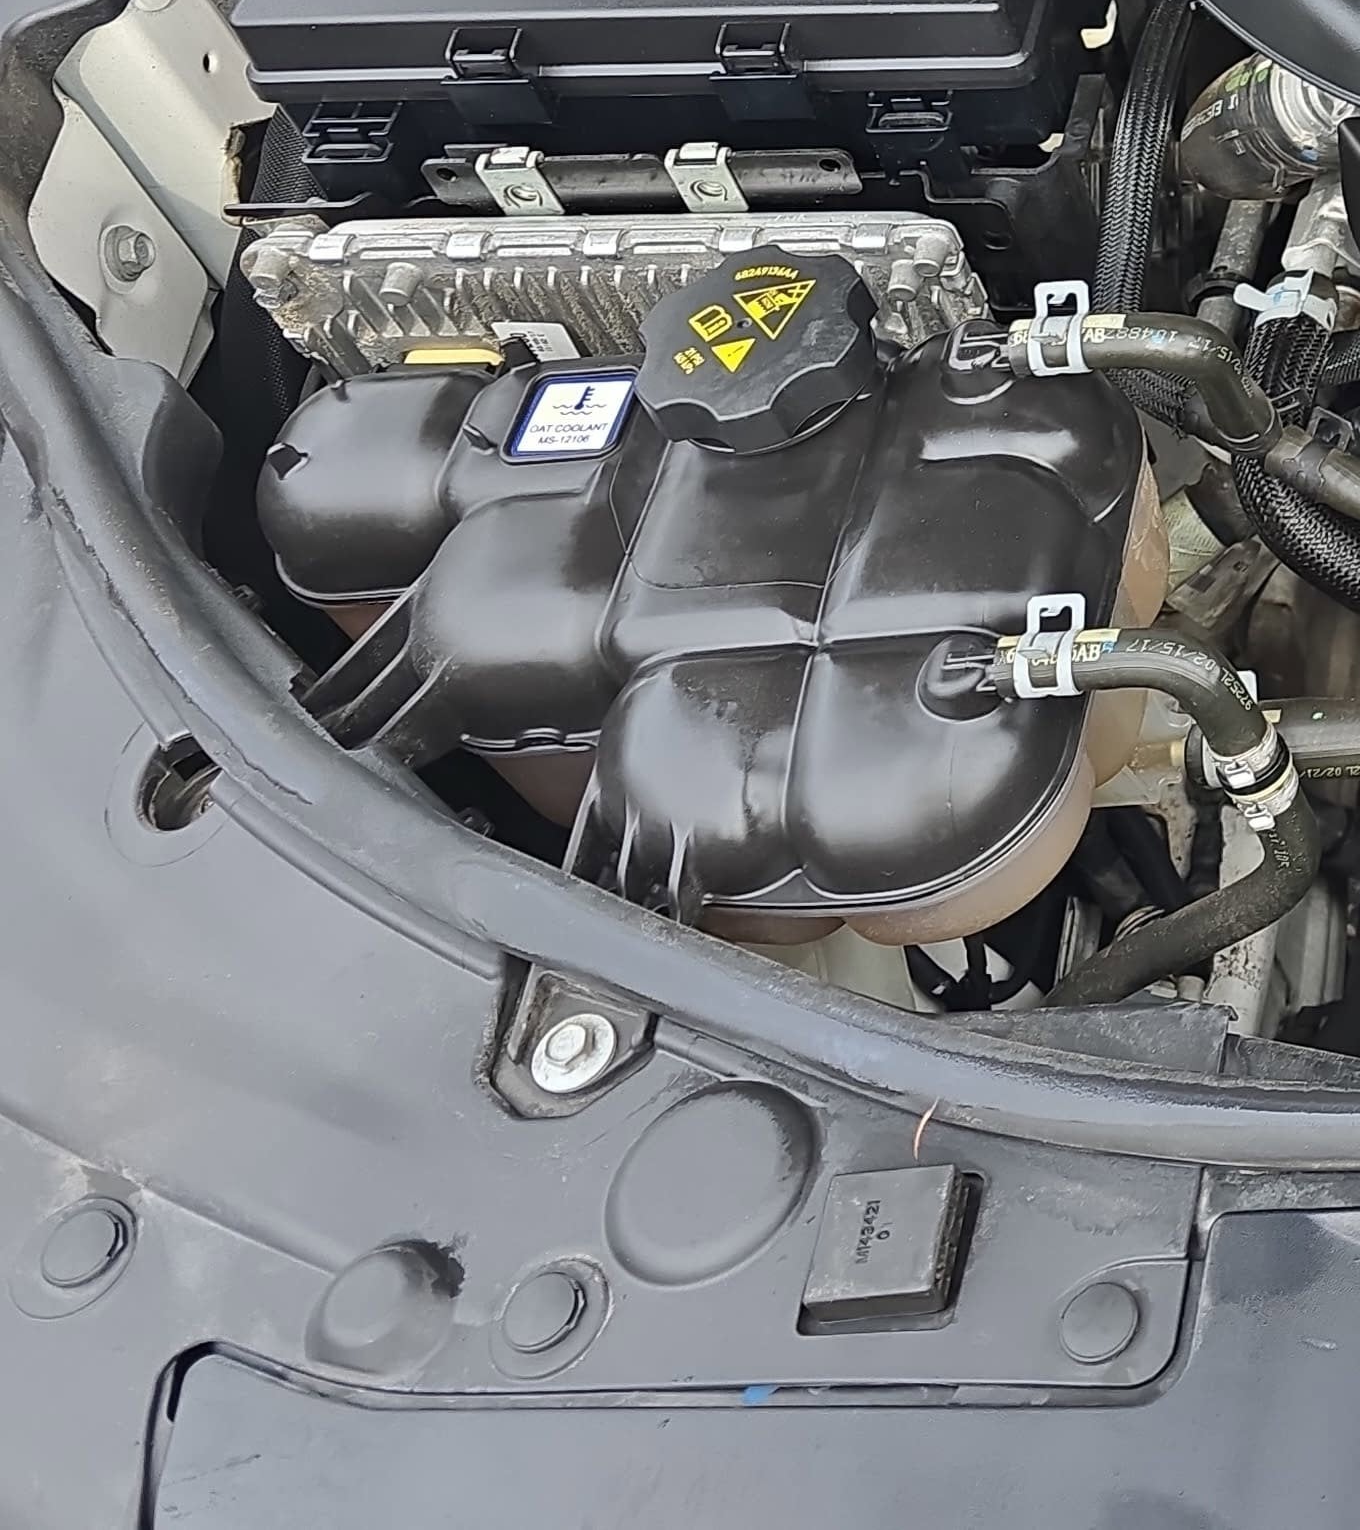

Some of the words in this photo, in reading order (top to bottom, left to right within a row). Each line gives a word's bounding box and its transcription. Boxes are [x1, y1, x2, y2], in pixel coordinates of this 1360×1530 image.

[529, 423, 553, 434] OAT
[554, 422, 609, 433] COOLANT
[537, 434, 590, 445] MS-12106
[1125, 638, 1217, 671] 02/15/17
